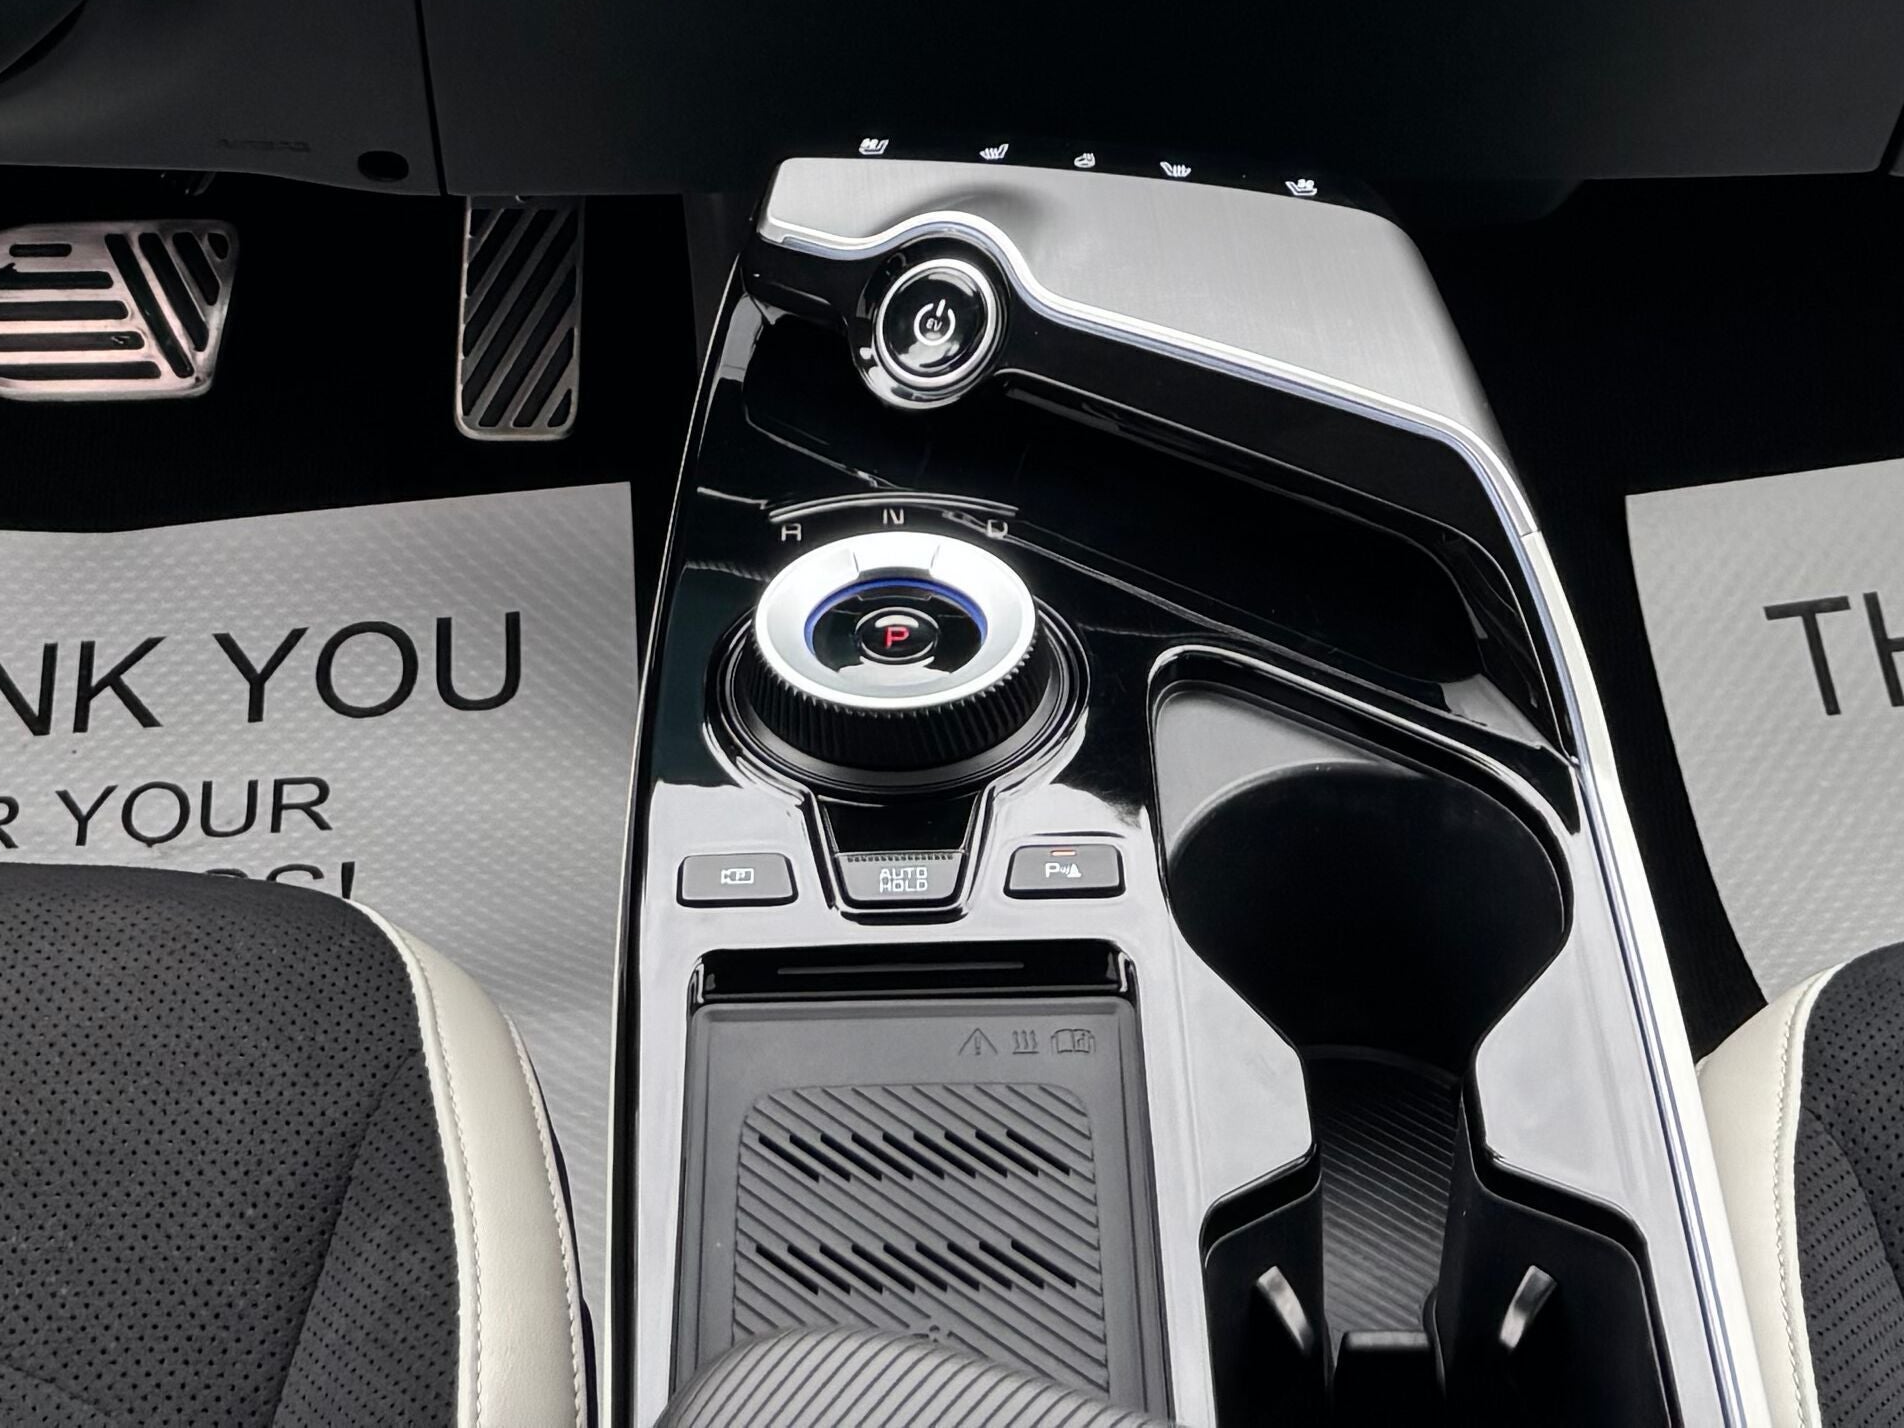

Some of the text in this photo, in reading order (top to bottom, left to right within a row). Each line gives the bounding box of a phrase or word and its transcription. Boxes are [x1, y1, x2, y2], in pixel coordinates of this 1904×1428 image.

[883, 508, 905, 524] N
[781, 524, 802, 542] R
[884, 626, 909, 648] P
[212, 611, 522, 724] YOU
[55, 775, 334, 847] YOUR
[880, 866, 927, 879] AUTO
[879, 878, 928, 892] HOLD
